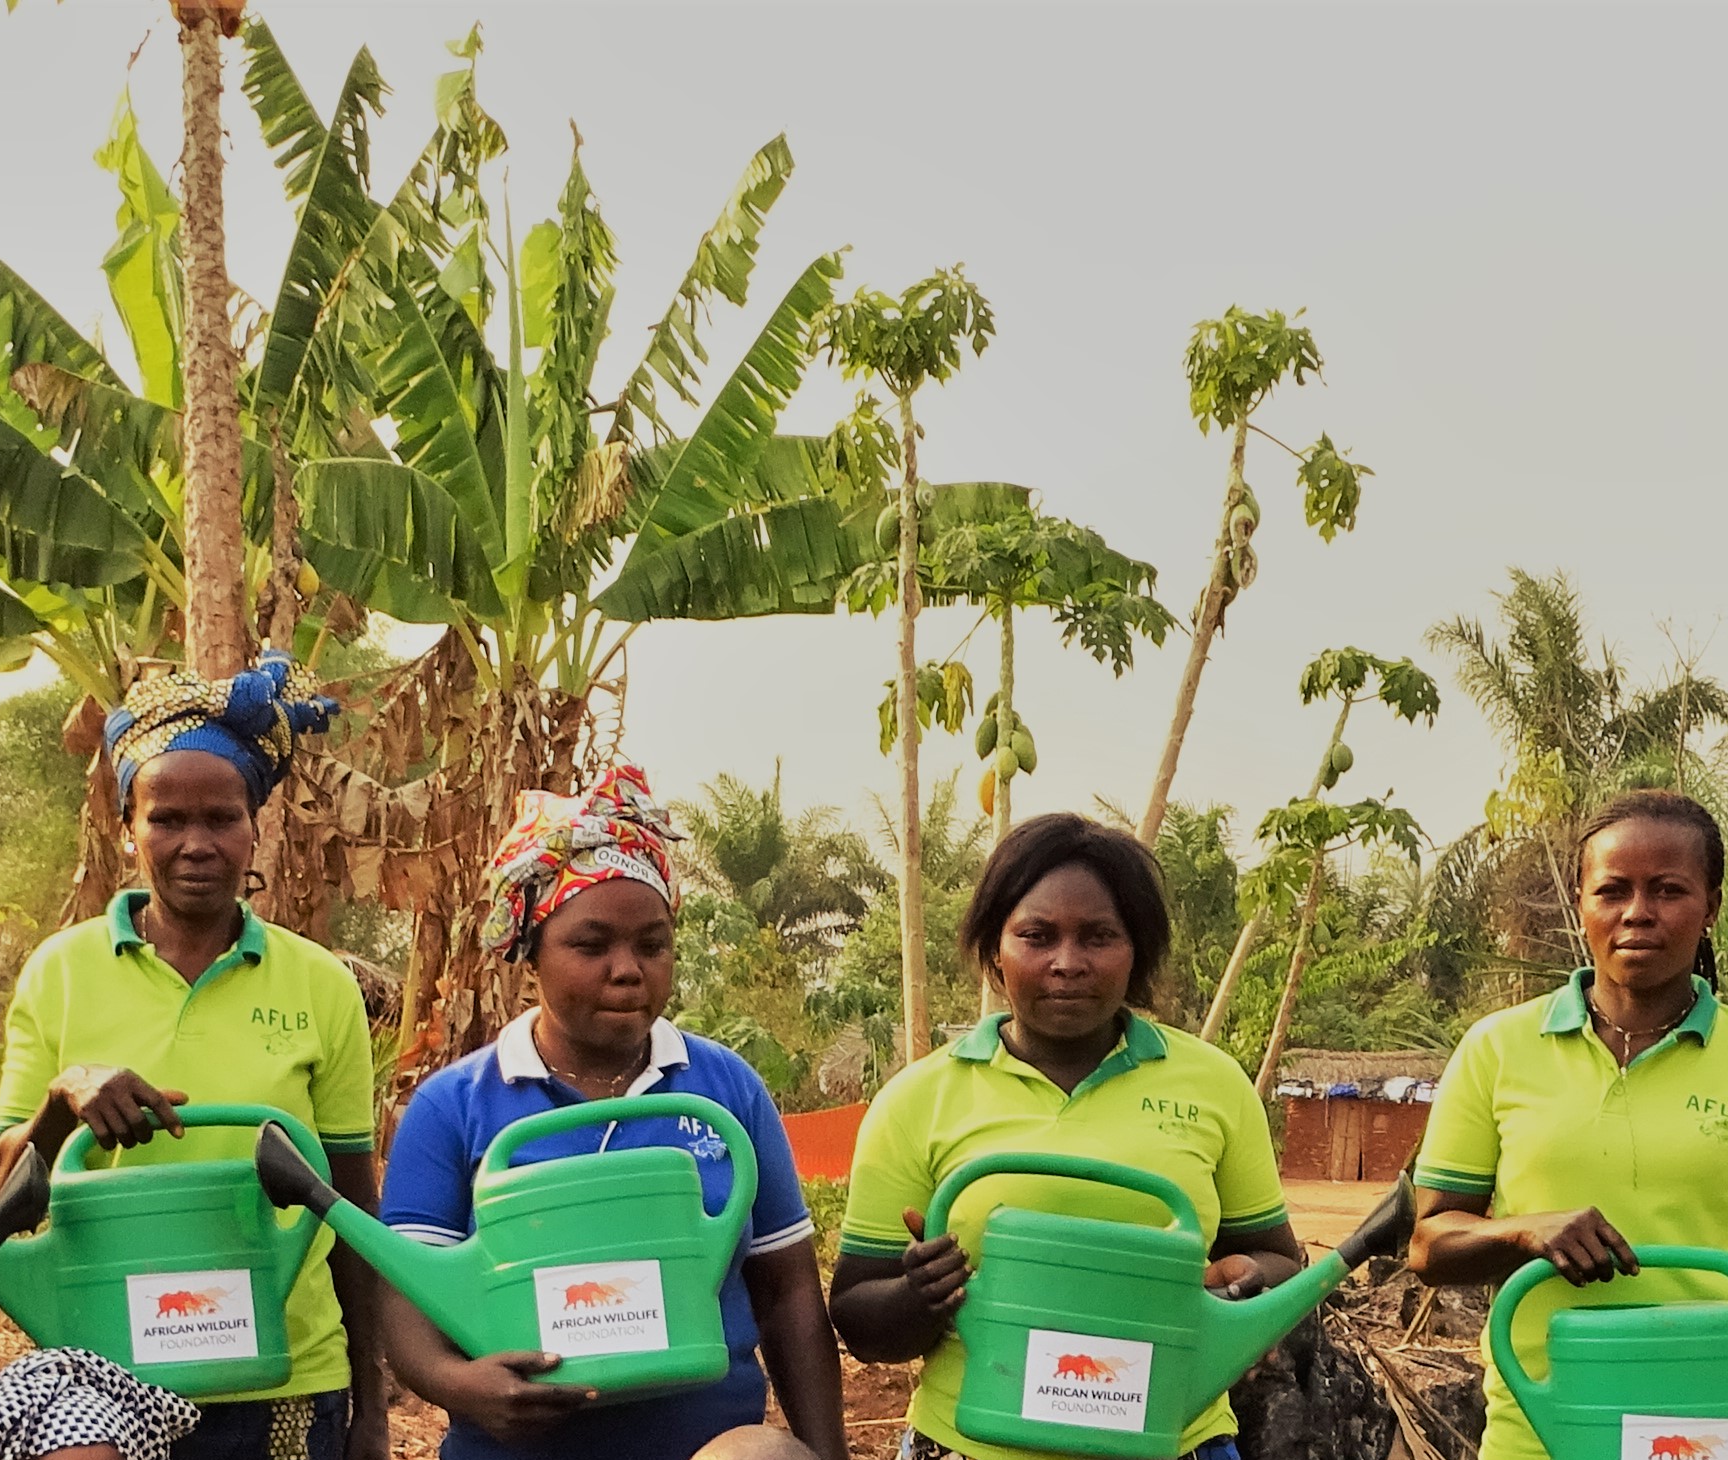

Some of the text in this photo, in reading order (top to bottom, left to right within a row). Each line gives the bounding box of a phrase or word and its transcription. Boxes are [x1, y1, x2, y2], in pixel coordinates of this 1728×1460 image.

[251, 1007, 309, 1031] AFLB
[678, 1115, 721, 1139] AFL
[143, 1318, 249, 1337] AFRICAN WILDLIFE
[551, 1309, 659, 1330] AFRICAN WILDLIFE
[160, 1334, 237, 1350] FOUNDATION
[567, 1325, 645, 1342] FOUNDATION
[1036, 1385, 1143, 1403] AFRICAN WILDLIFE
[1051, 1400, 1128, 1416] FOUNDATION
